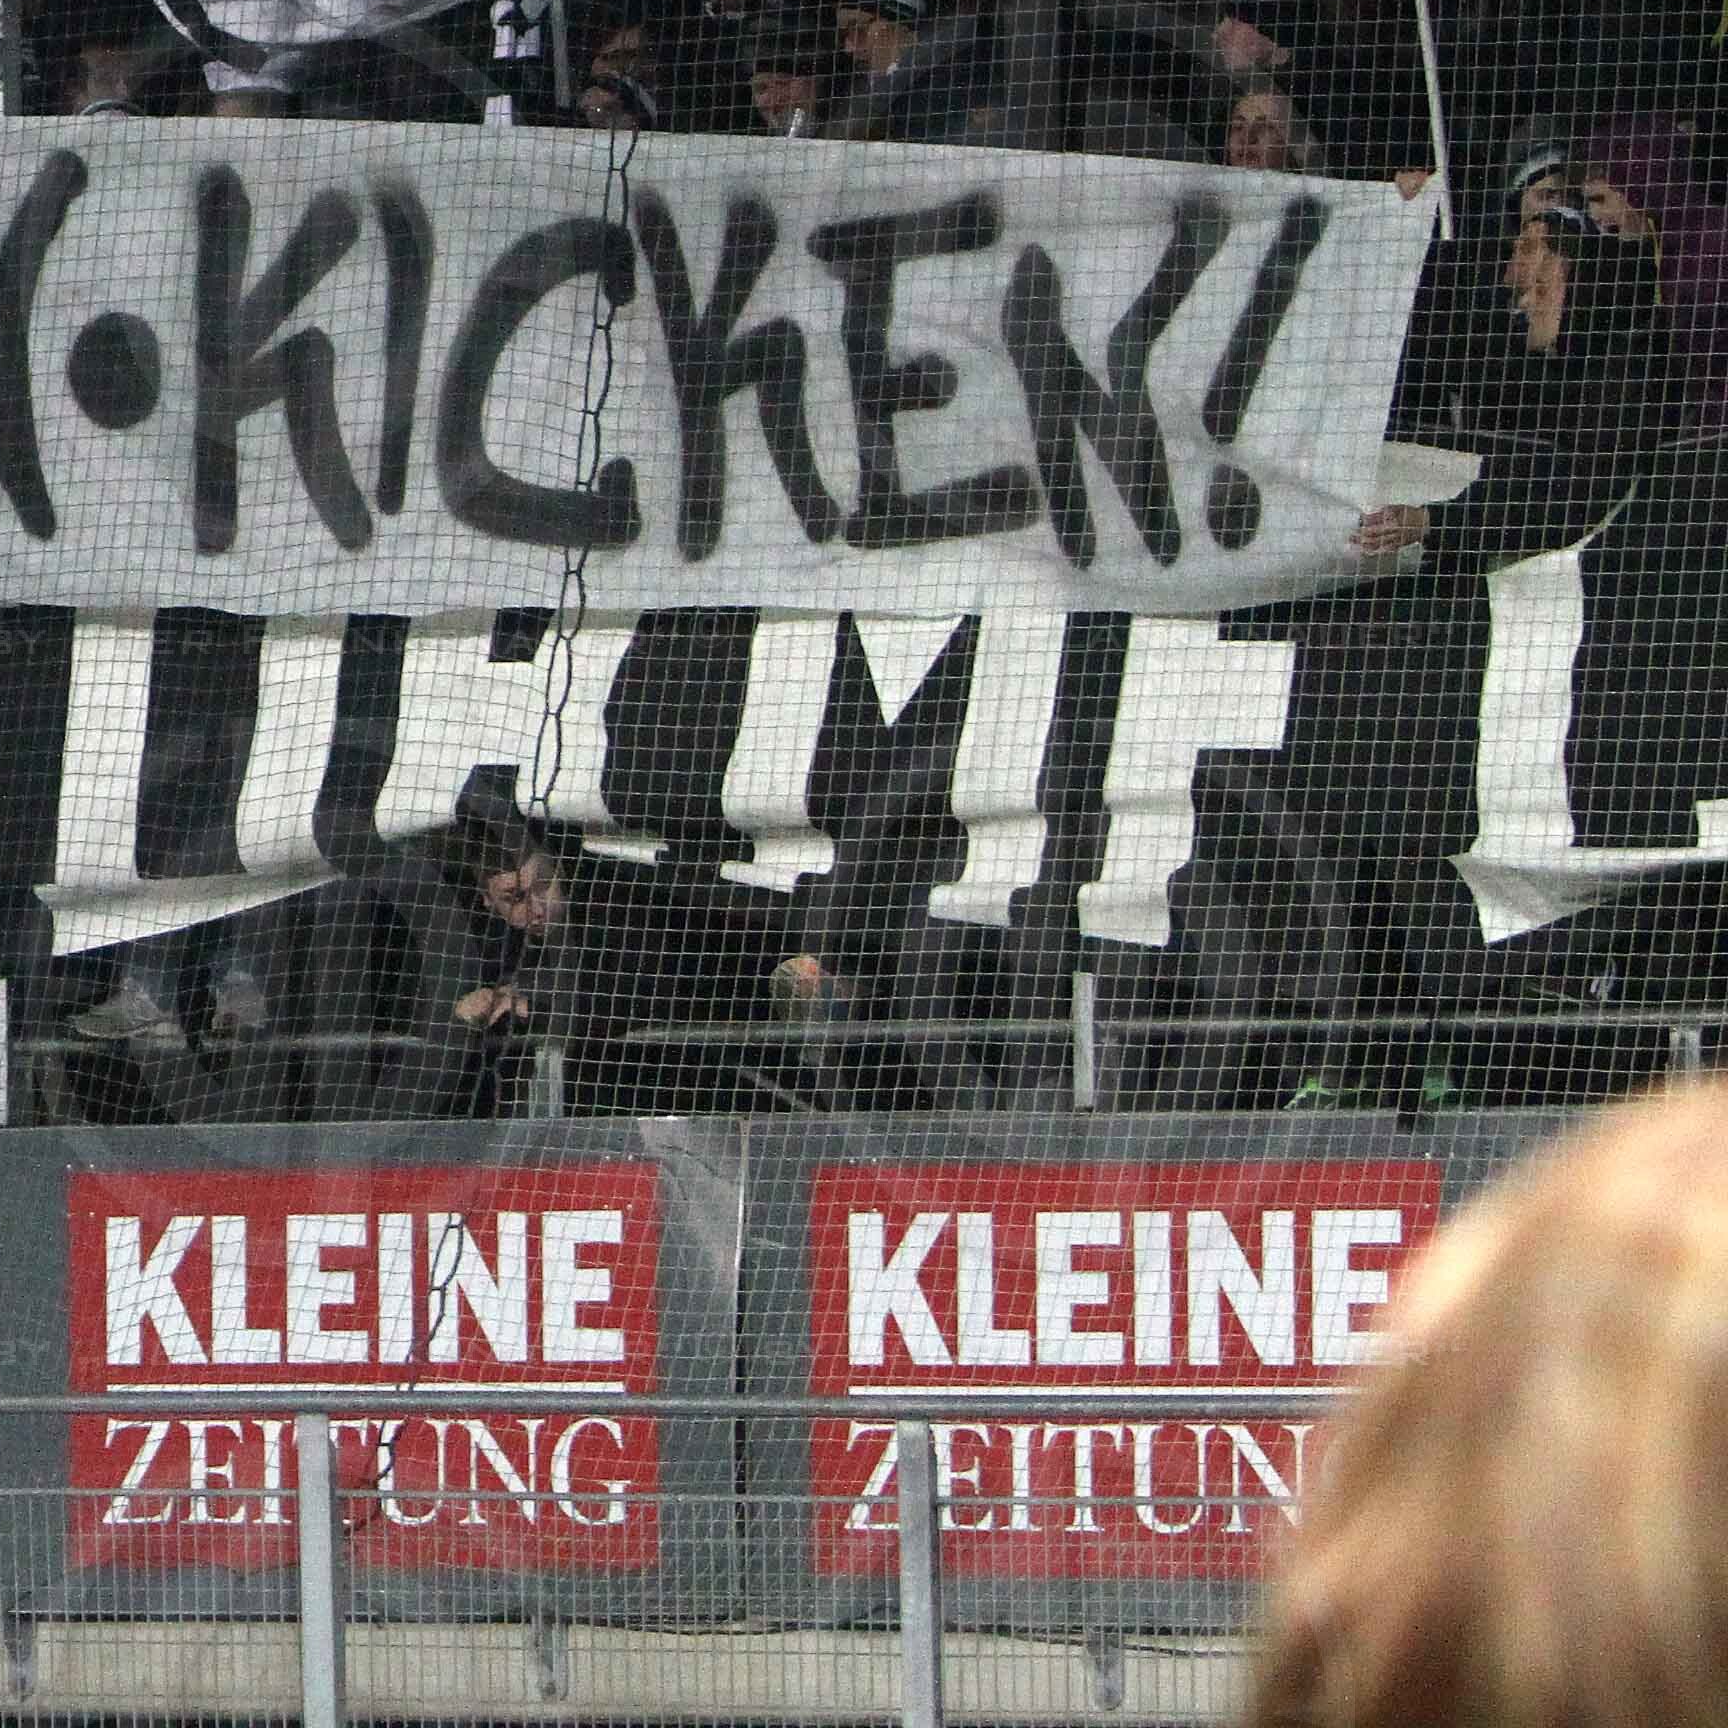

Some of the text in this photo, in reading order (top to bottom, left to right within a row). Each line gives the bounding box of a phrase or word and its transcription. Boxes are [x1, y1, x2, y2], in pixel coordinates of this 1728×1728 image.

[192, 160, 1330, 570] KICKEN!
[104, 1209, 625, 1365] KLEINE
[847, 1209, 1404, 1367] KLEINE
[843, 1419, 1319, 1534] ZEITUN
